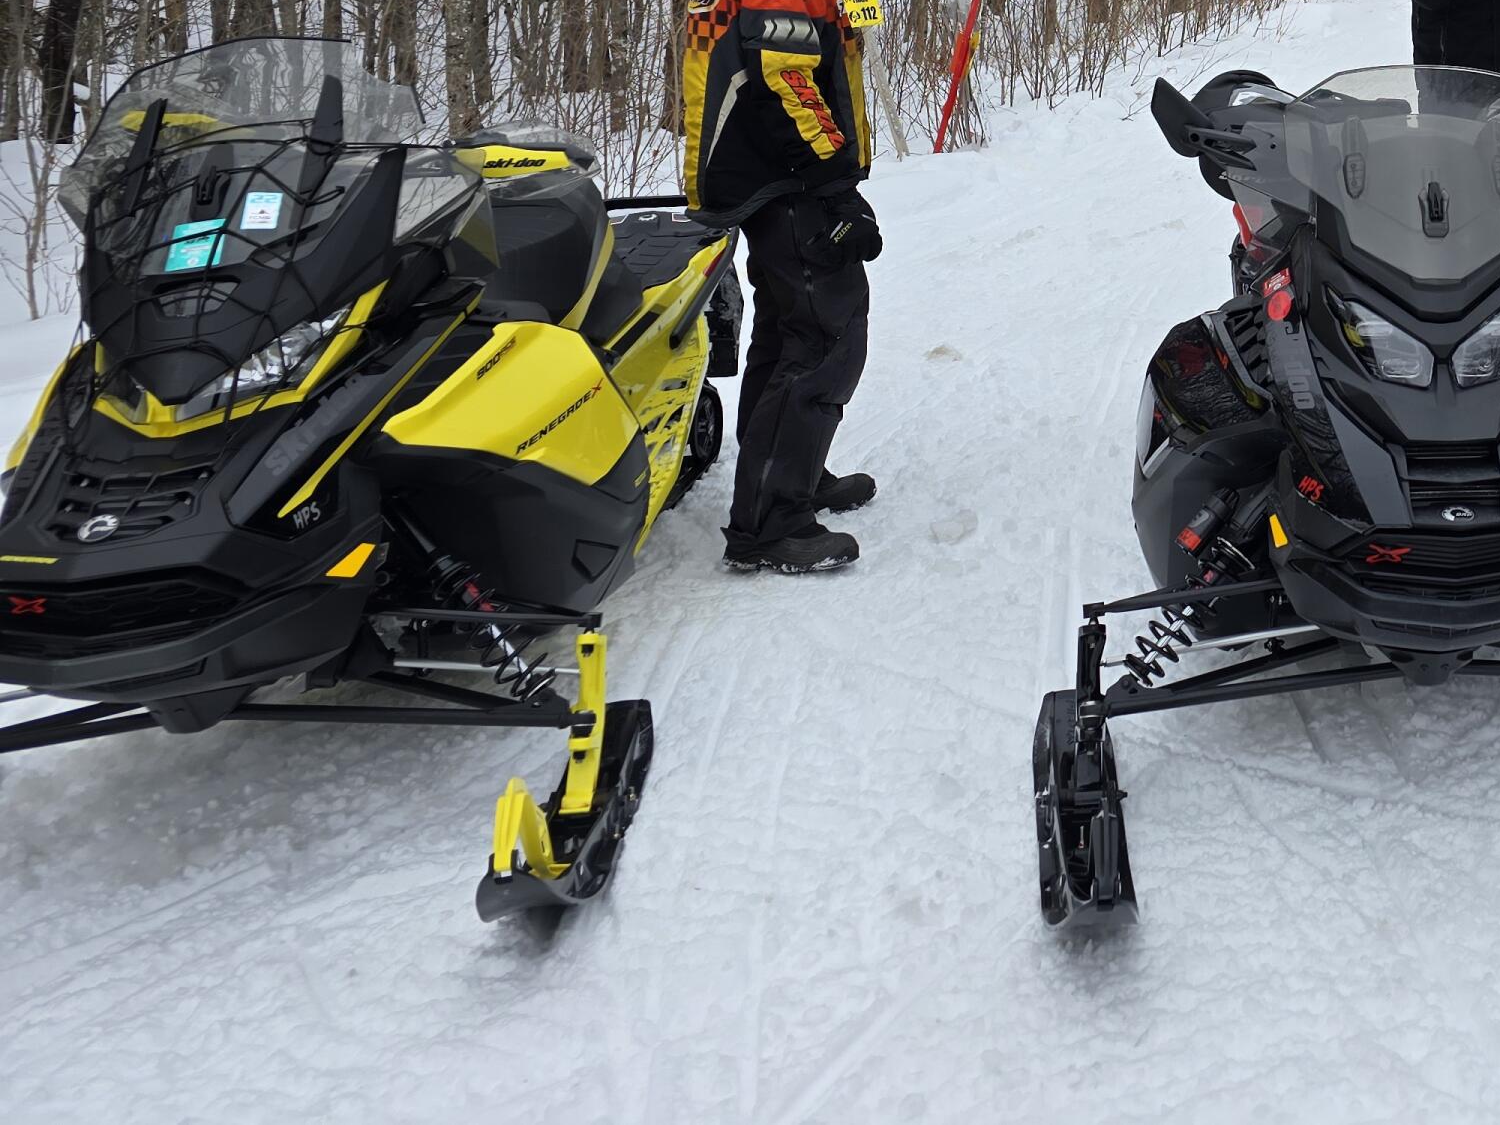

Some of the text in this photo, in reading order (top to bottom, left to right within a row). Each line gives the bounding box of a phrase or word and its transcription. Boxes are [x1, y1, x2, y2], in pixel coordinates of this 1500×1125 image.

[861, 6, 878, 20] 112
[483, 157, 547, 169] ski-doo
[476, 350, 502, 380] 900
[516, 389, 593, 455] RENEGADE
[1297, 475, 1325, 502] HPS
[292, 500, 322, 530] HPS
